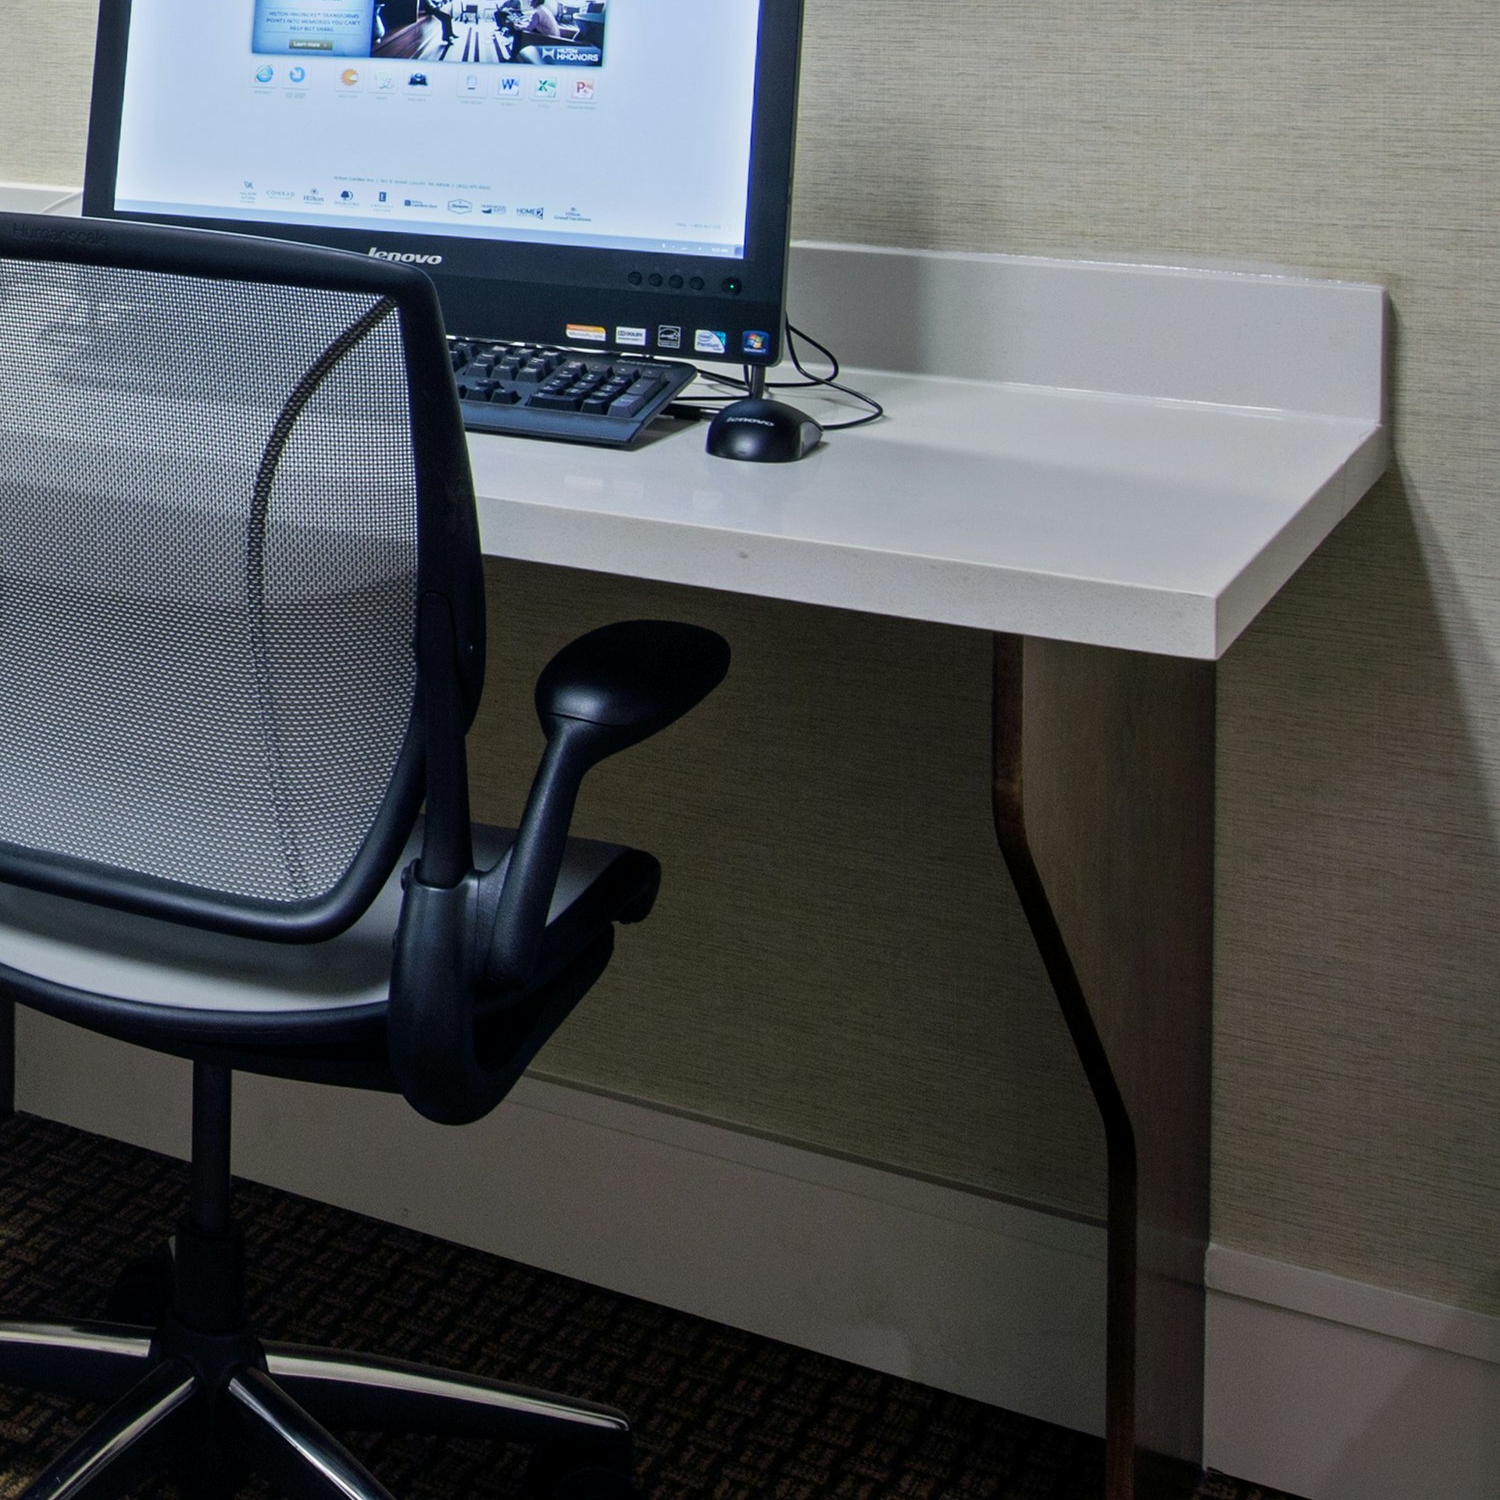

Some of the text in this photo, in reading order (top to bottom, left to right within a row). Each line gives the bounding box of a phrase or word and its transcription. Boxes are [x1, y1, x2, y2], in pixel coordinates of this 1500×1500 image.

[556, 52, 599, 62] HHONORS
[368, 247, 443, 265] lenovo
[726, 416, 775, 427] lenovo
